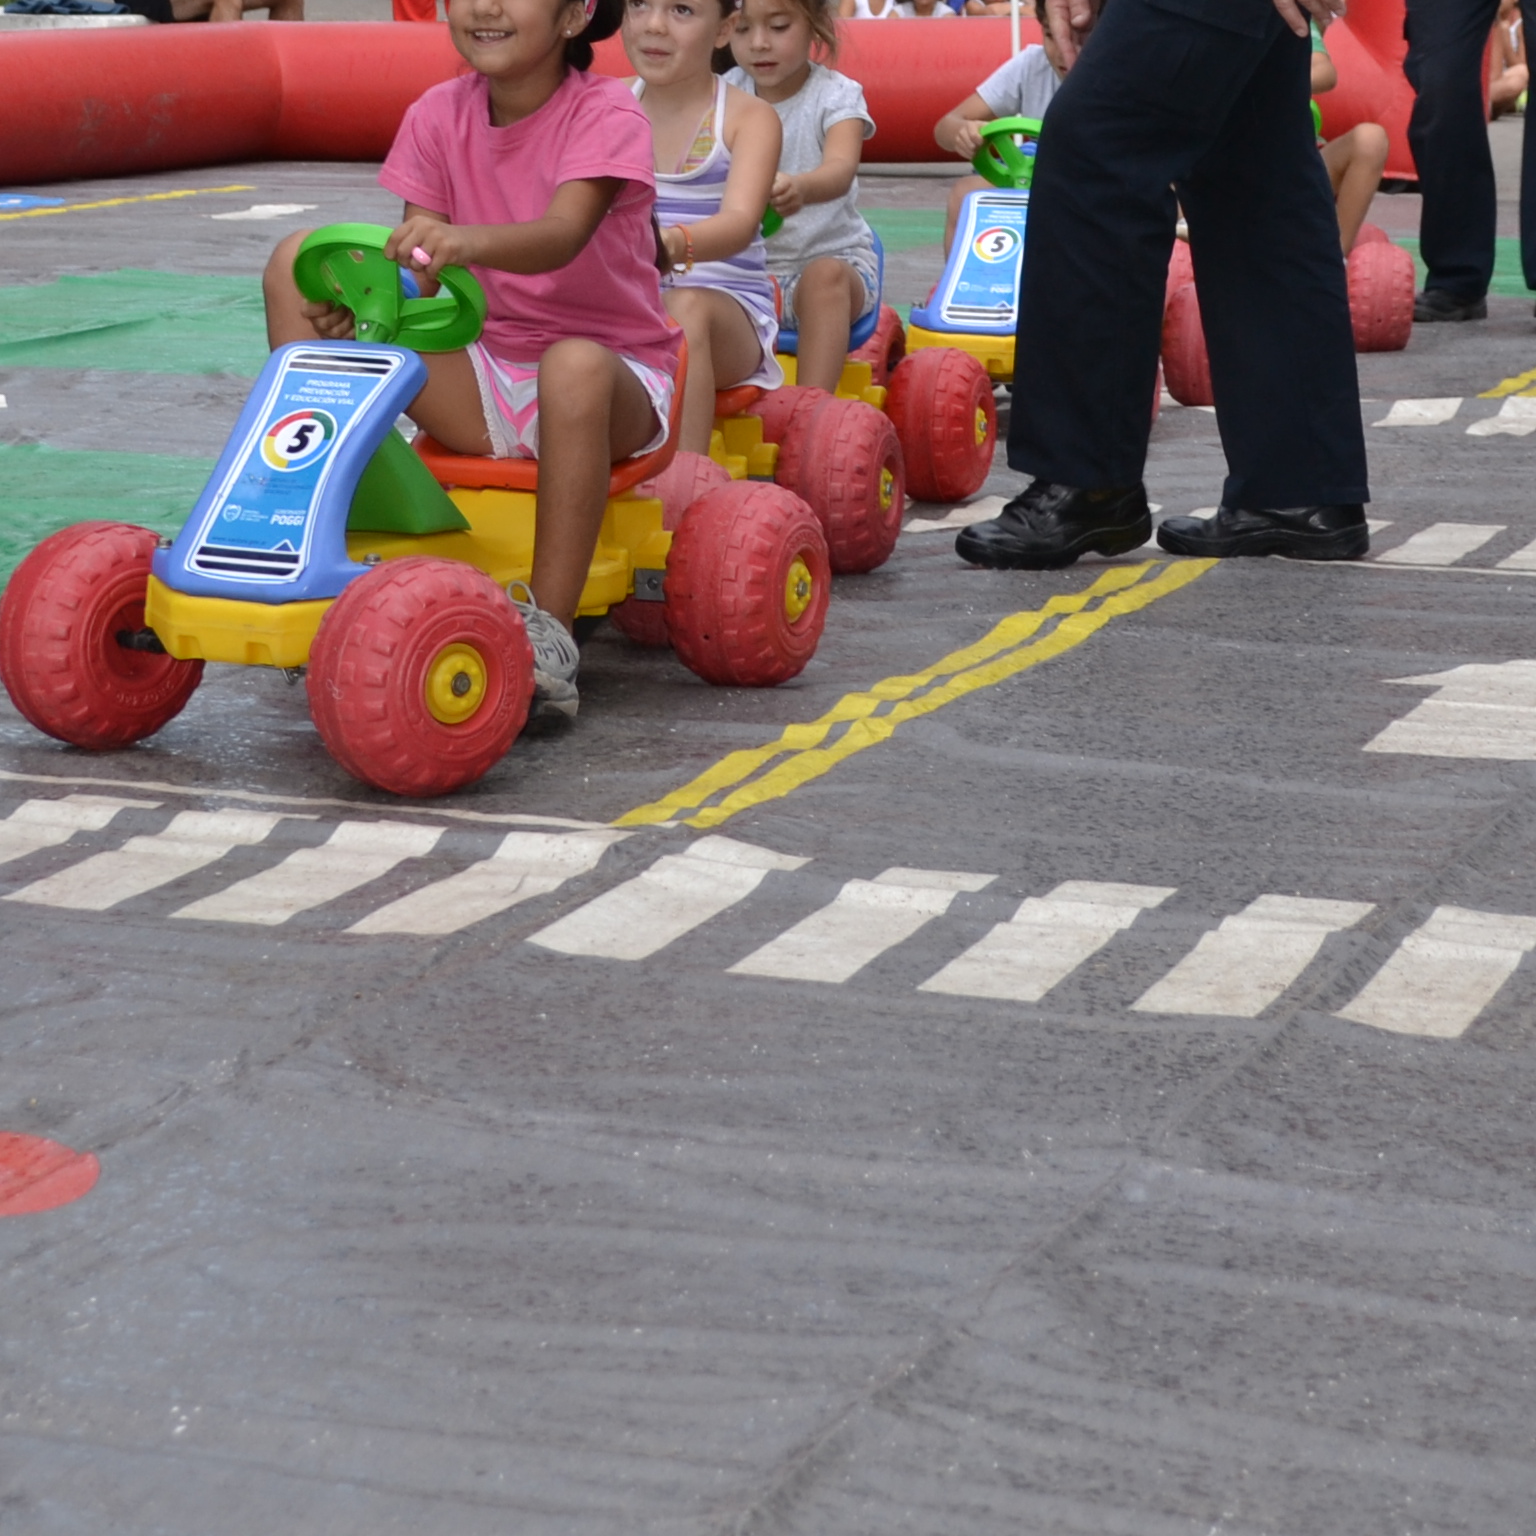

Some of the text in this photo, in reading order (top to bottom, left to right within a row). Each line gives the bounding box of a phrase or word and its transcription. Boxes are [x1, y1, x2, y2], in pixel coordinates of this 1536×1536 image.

[990, 236, 1006, 253] 5
[286, 424, 317, 454] 5
[270, 514, 305, 526] POGGI
